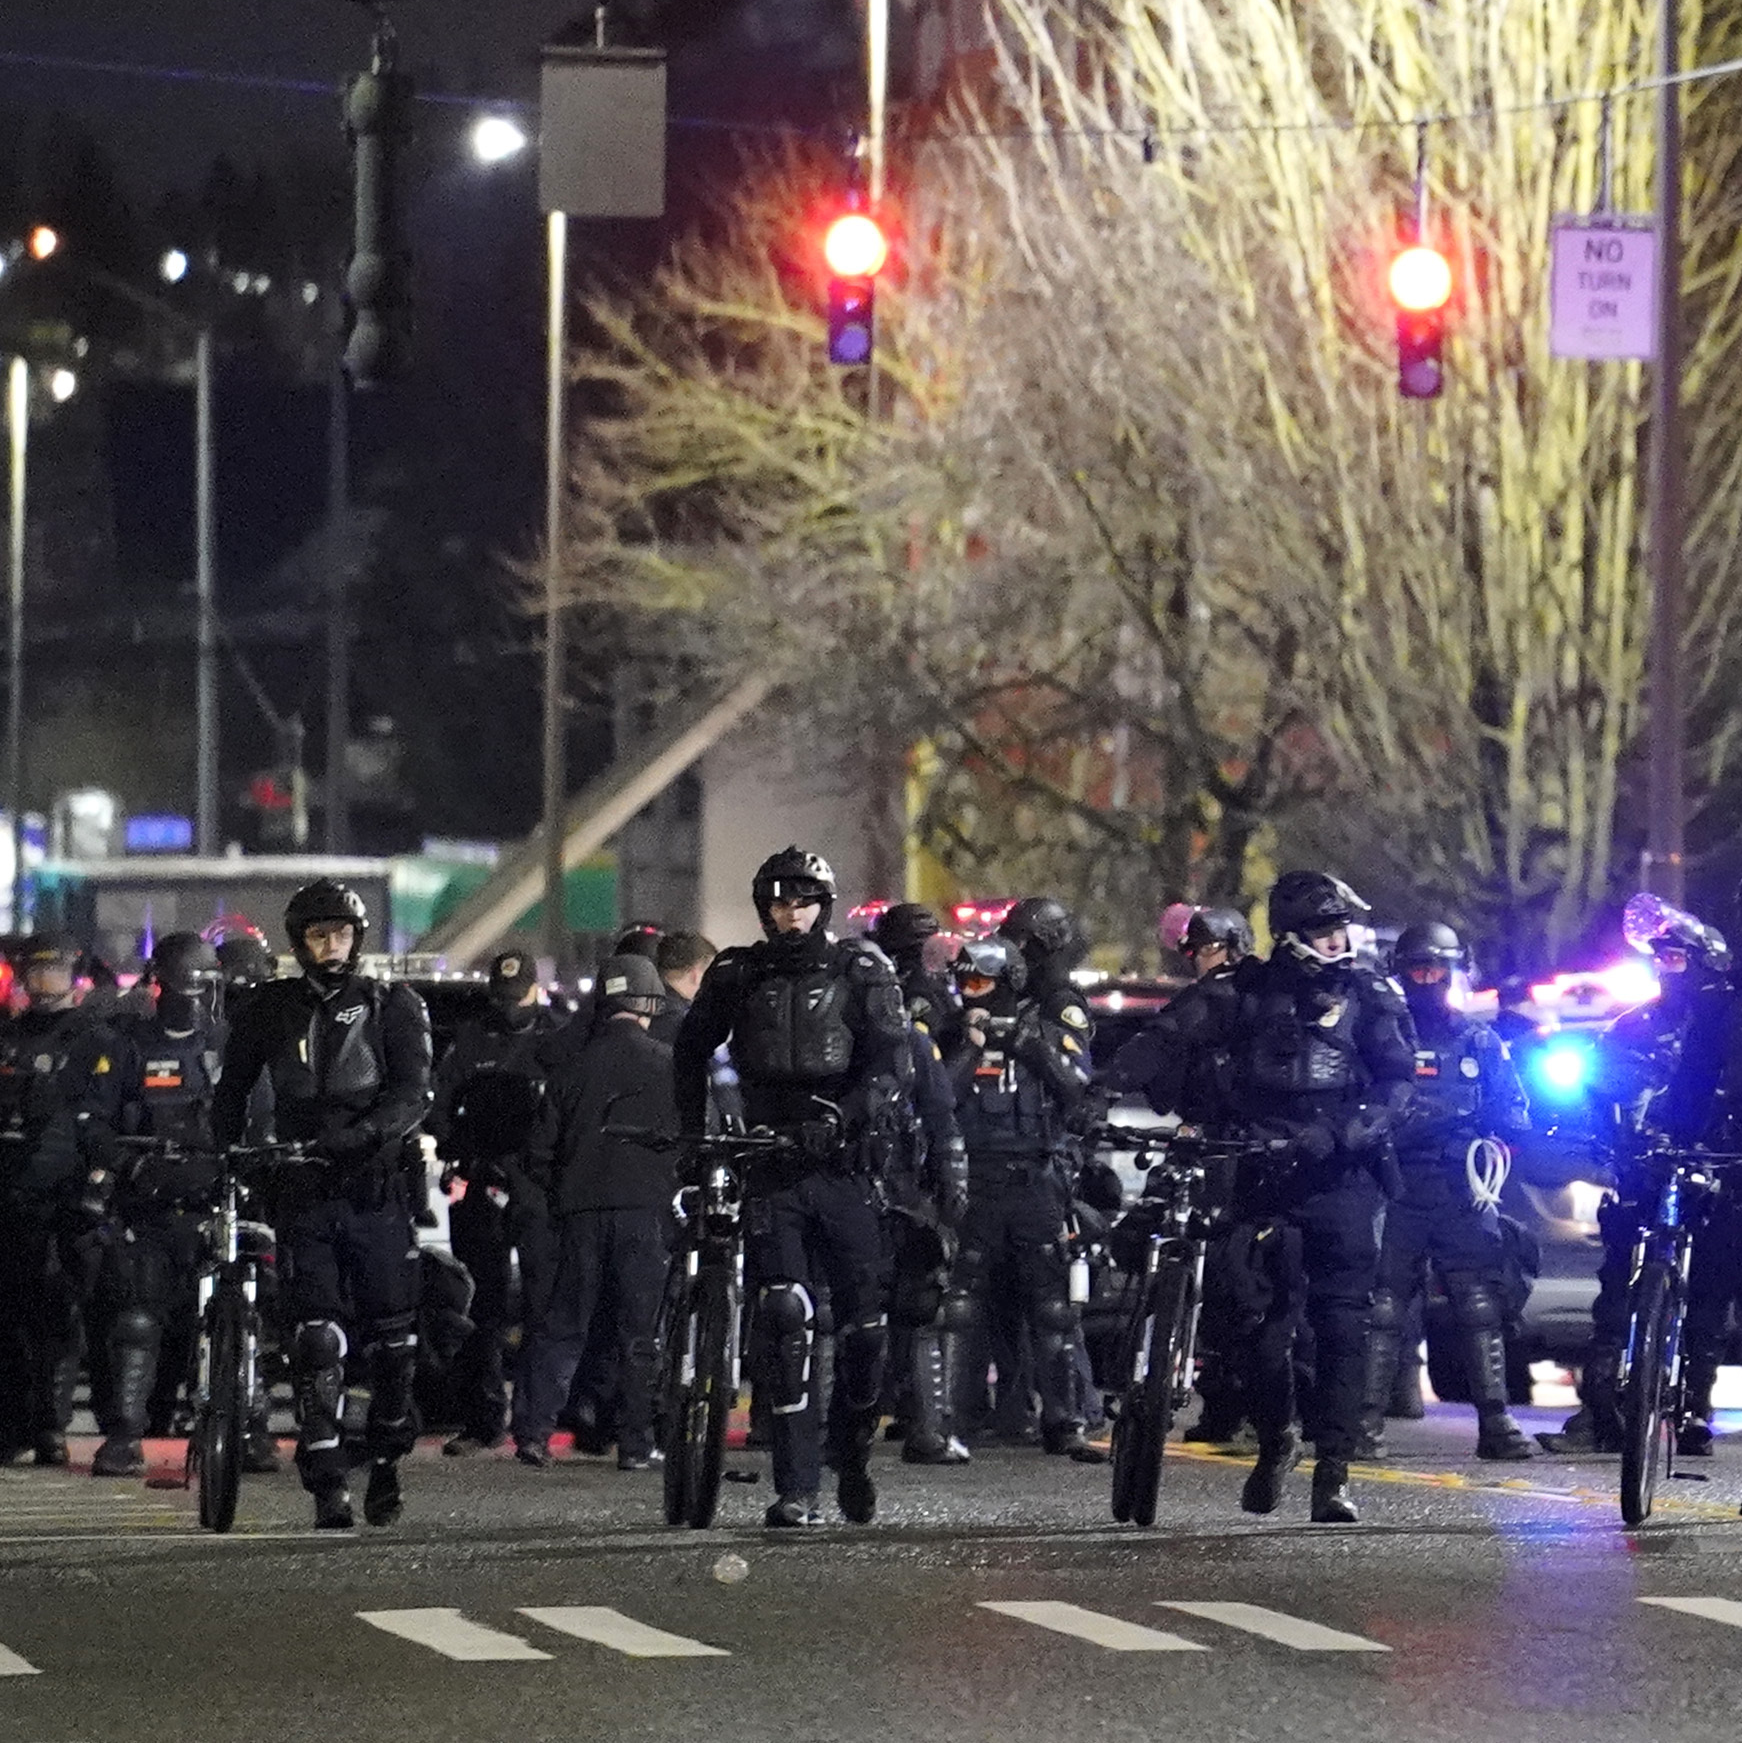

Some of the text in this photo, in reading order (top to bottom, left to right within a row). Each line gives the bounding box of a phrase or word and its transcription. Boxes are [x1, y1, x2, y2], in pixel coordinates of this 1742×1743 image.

[1584, 238, 1624, 263] NO
[1577, 271, 1632, 292] TURN
[1587, 299, 1618, 320] ON
